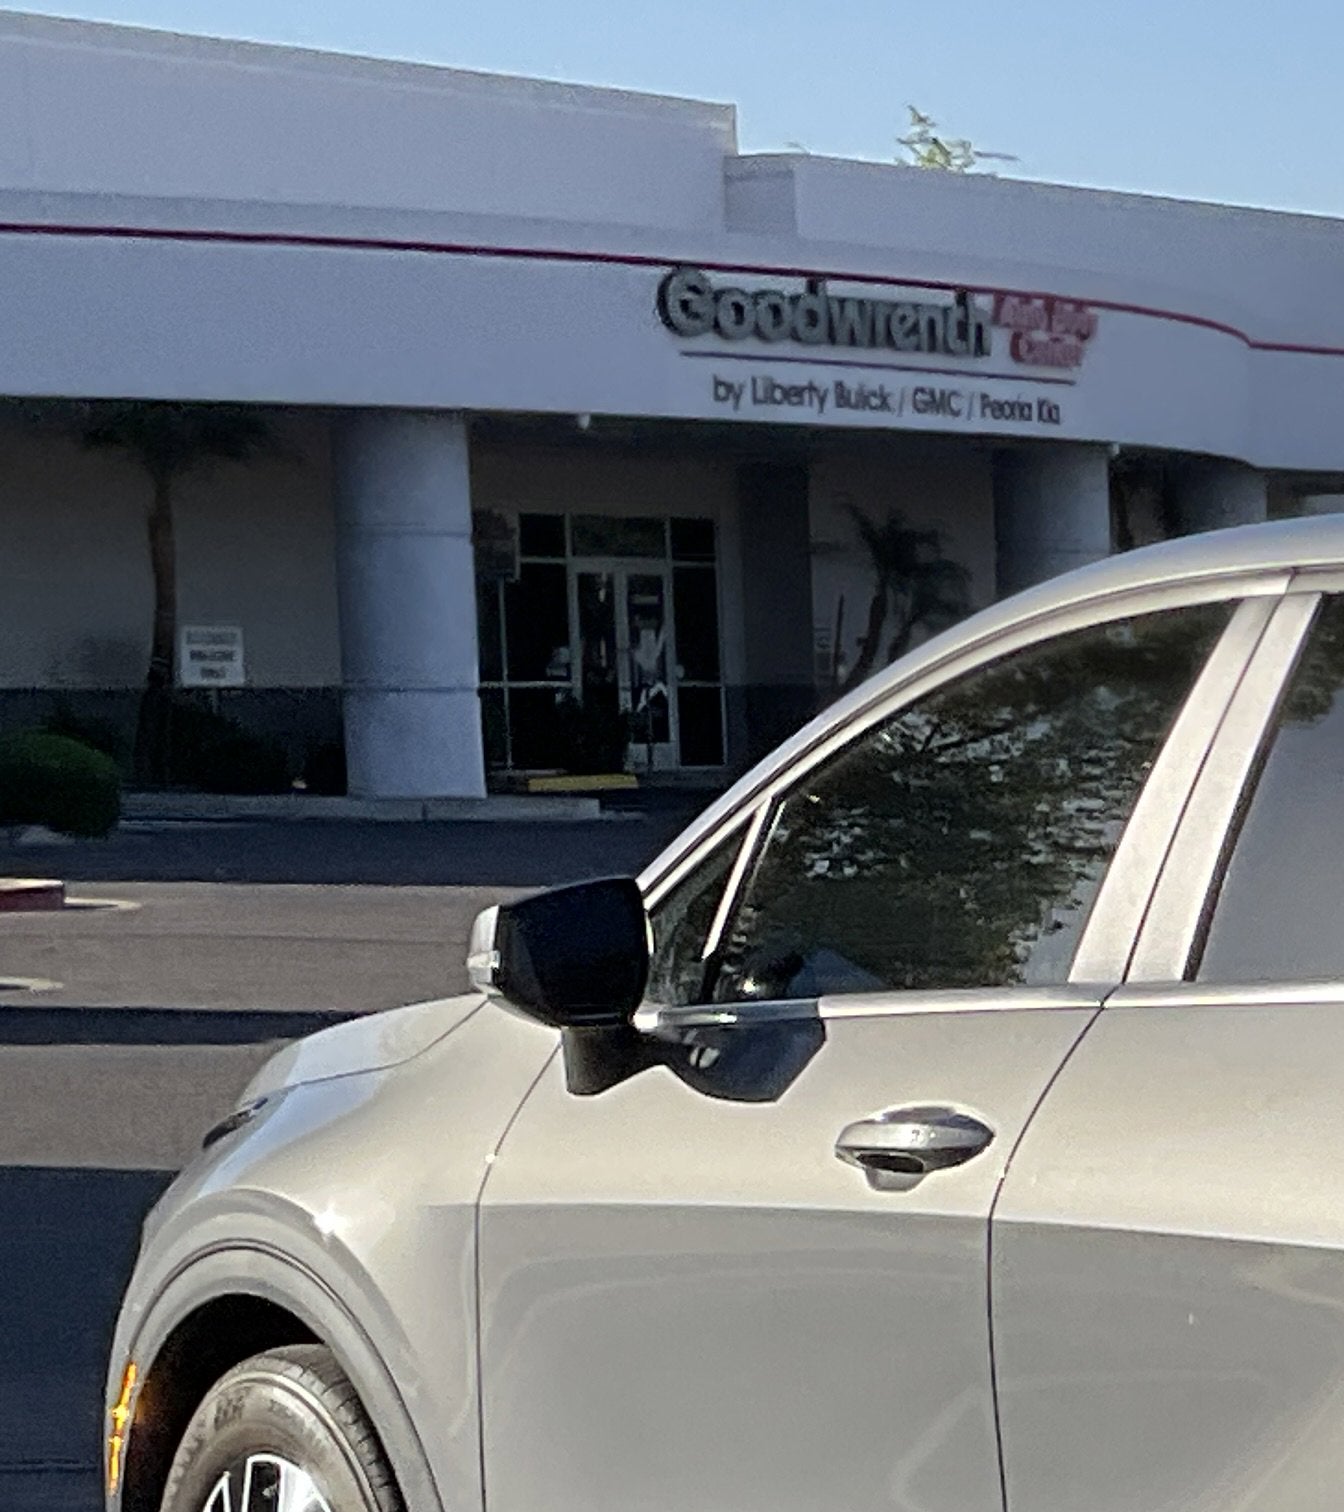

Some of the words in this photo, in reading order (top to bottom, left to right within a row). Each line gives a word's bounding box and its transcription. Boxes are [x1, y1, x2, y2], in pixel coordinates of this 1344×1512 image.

[656, 265, 992, 358] Goodwrench
[712, 373, 747, 412] by
[751, 374, 830, 415] Liberty
[833, 379, 893, 412] Buick
[912, 385, 963, 418] GMC
[979, 391, 1033, 422] Peoria
